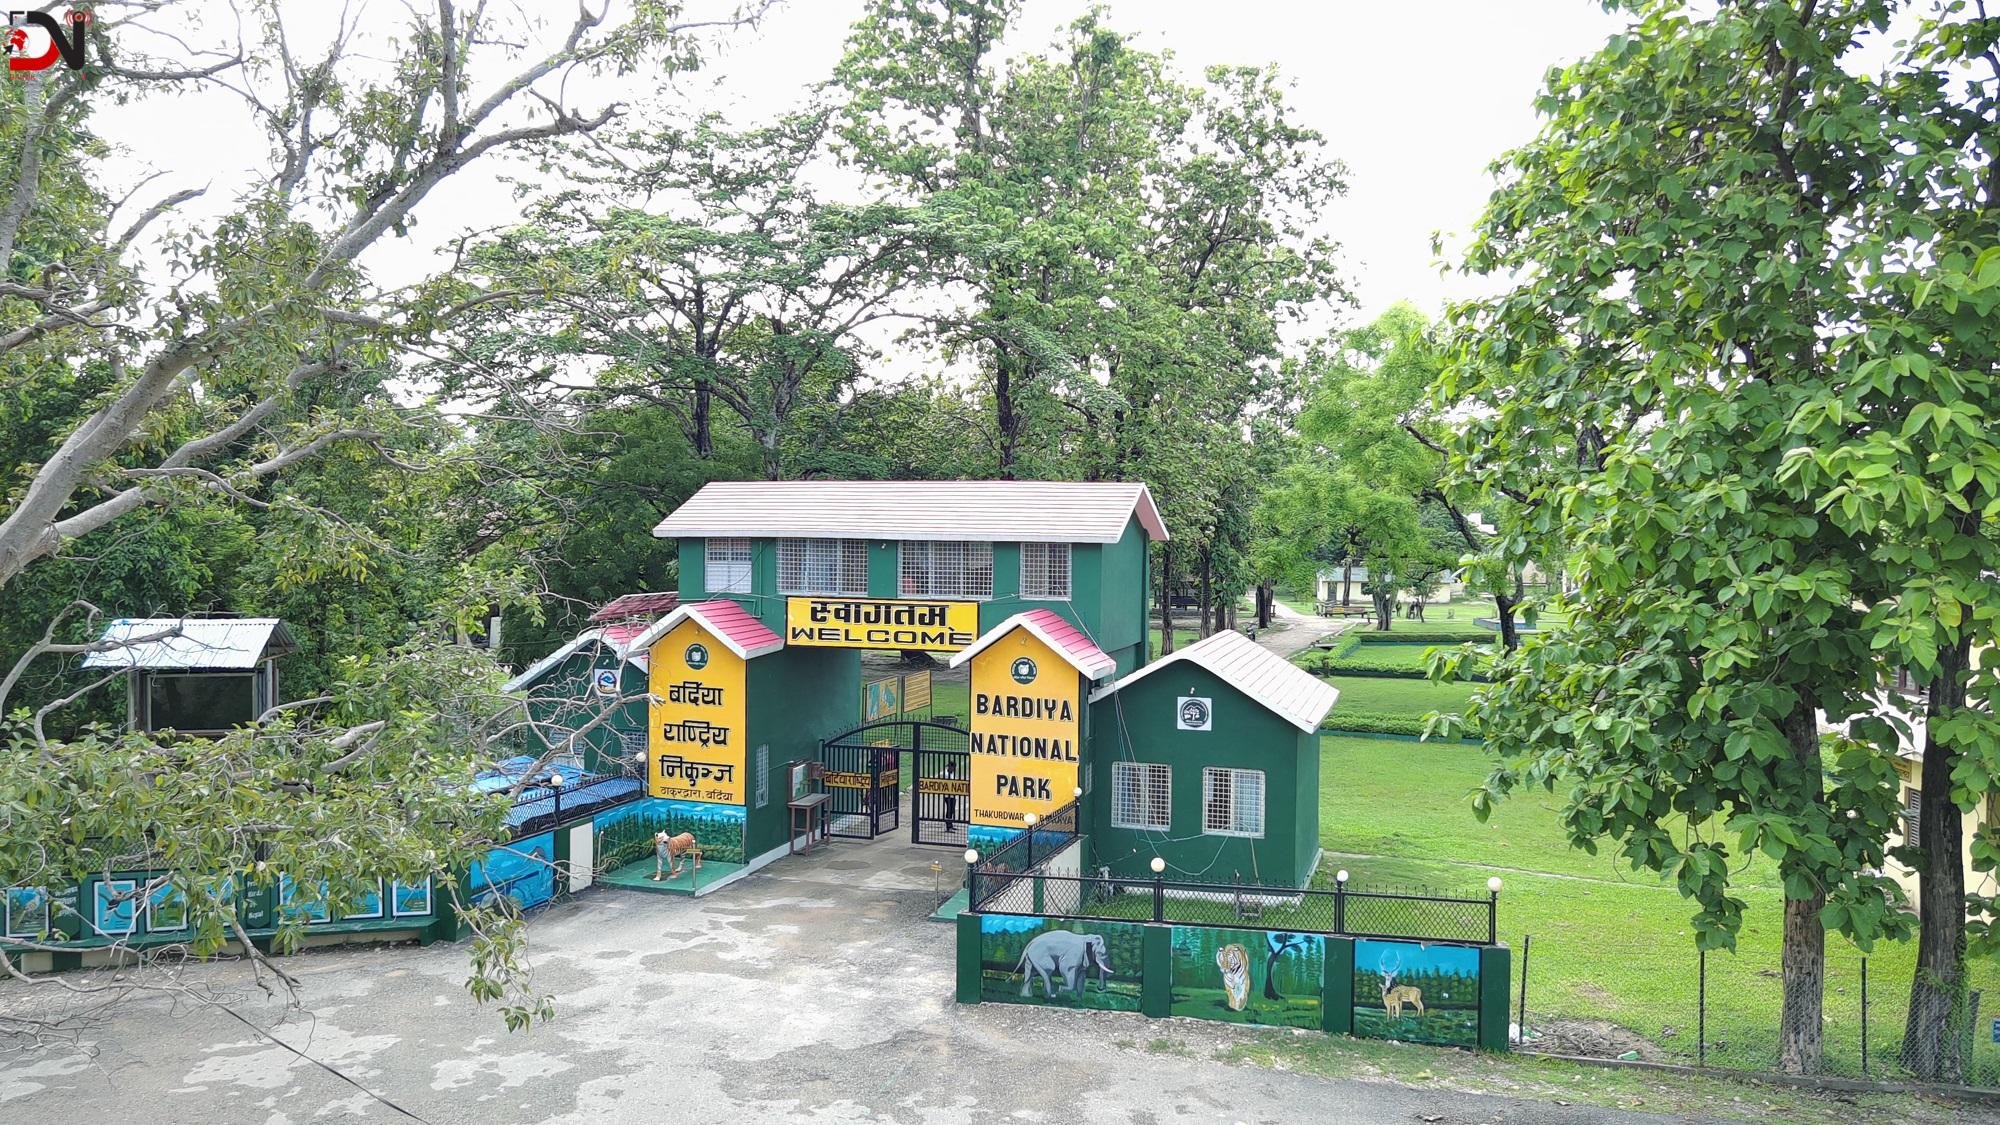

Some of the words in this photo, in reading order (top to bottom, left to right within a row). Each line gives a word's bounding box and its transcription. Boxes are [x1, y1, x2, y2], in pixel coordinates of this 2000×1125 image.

[791, 627, 973, 645] WELCOME
[976, 693, 1073, 722] BARDIYA
[971, 732, 1078, 763] NATIONAL
[996, 774, 1051, 800] PARK
[974, 809, 1025, 821] THAKURDWAR
